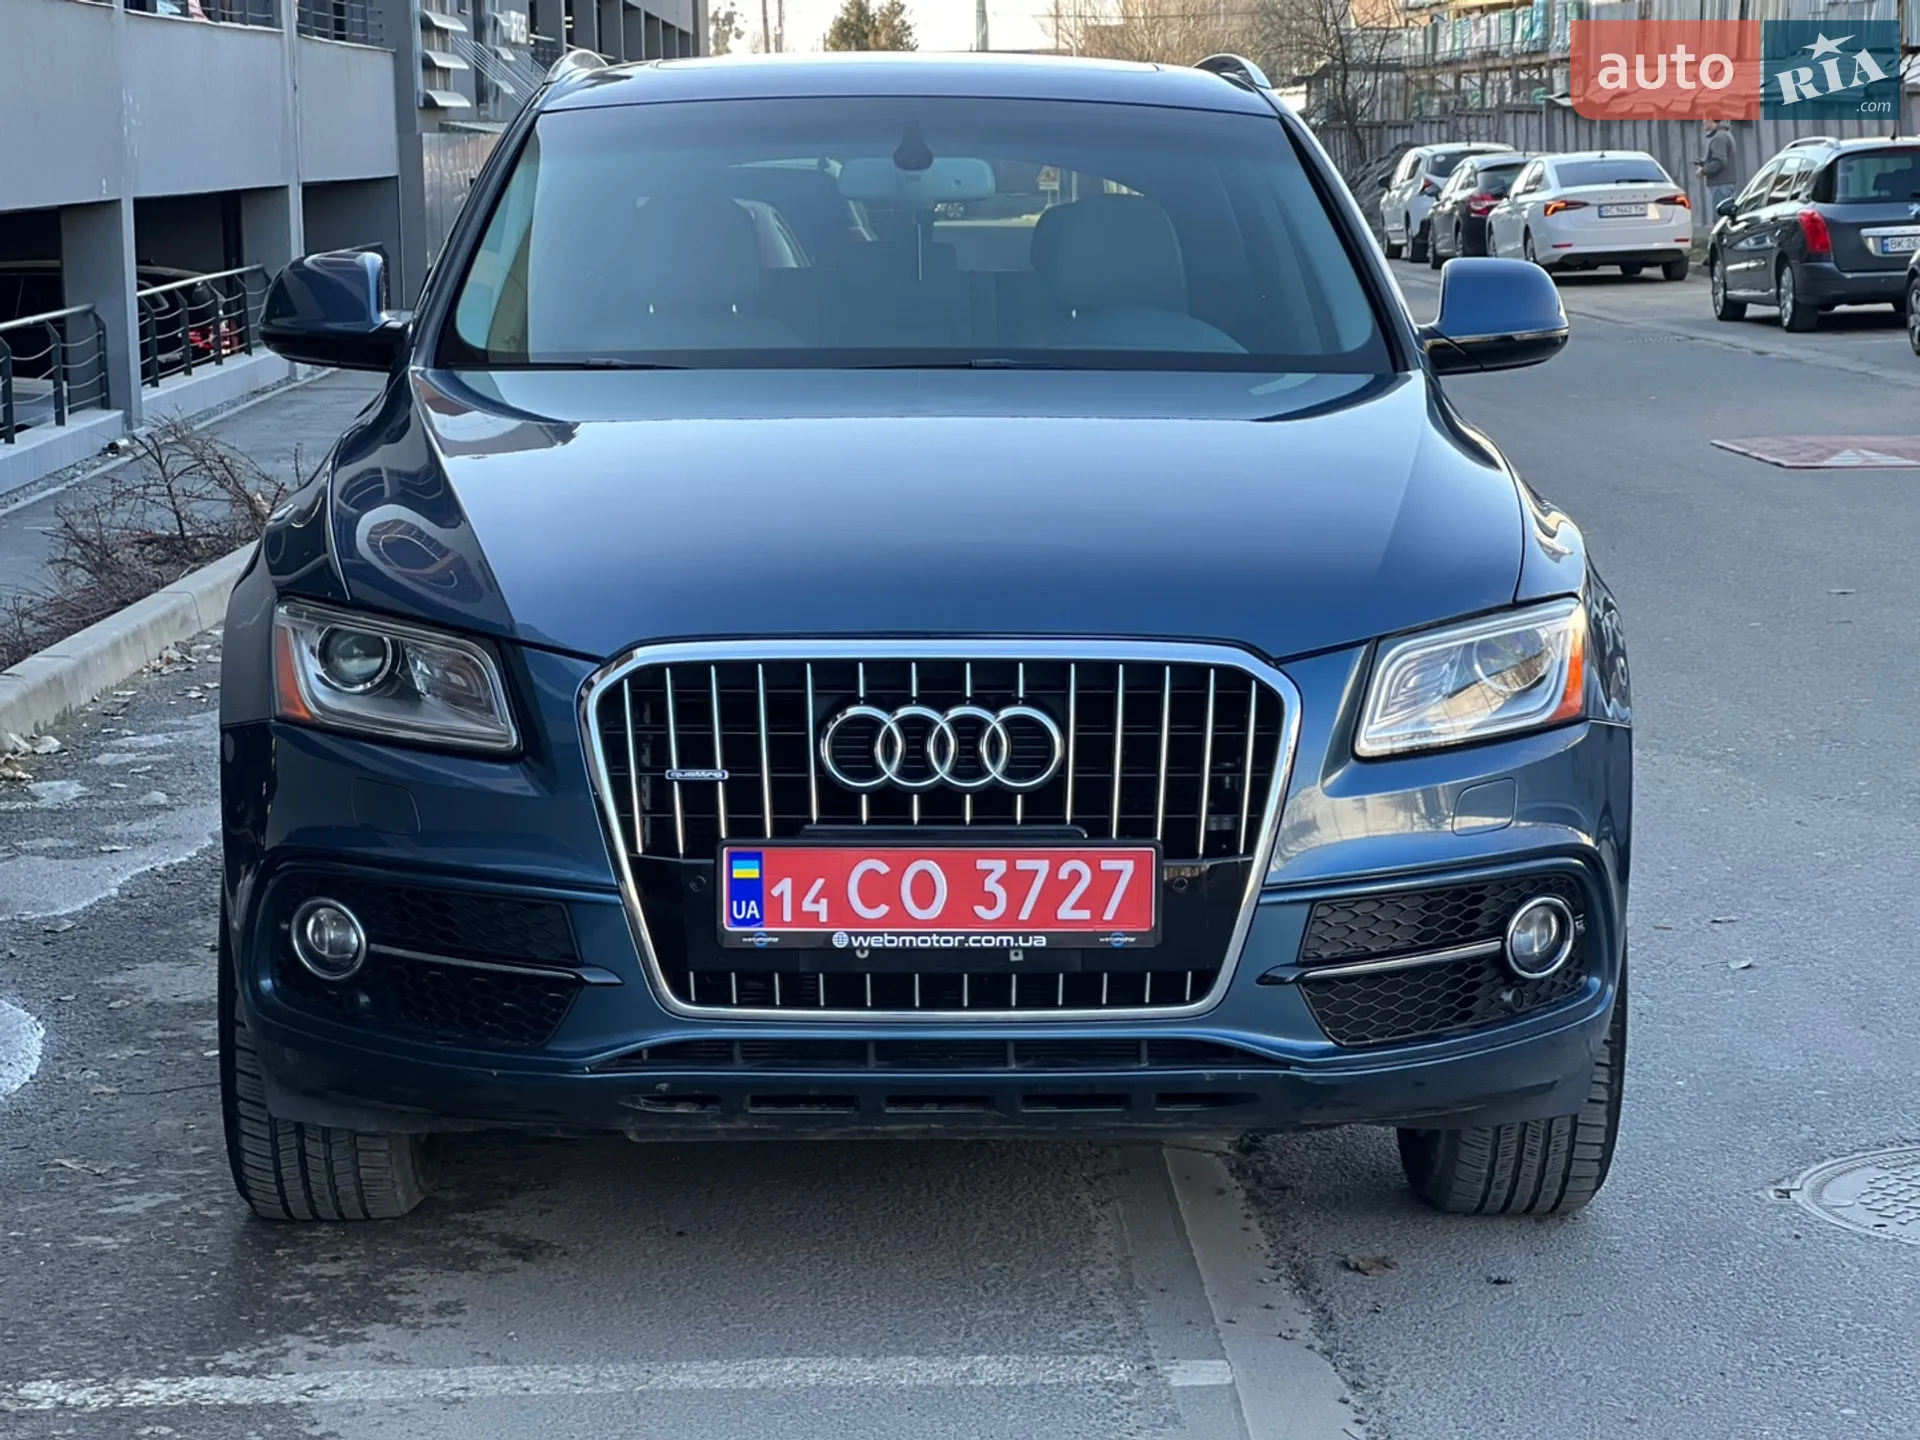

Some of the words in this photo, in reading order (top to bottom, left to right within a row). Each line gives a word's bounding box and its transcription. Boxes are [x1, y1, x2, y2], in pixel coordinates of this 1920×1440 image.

[1890, 237, 1904, 250] BK
[670, 770, 723, 779] quattro
[770, 877, 828, 923] 14
[847, 858, 948, 920] CO
[973, 858, 1135, 921] 3727
[732, 900, 760, 920] UA
[850, 932, 1047, 948] webmotor.com.ua
